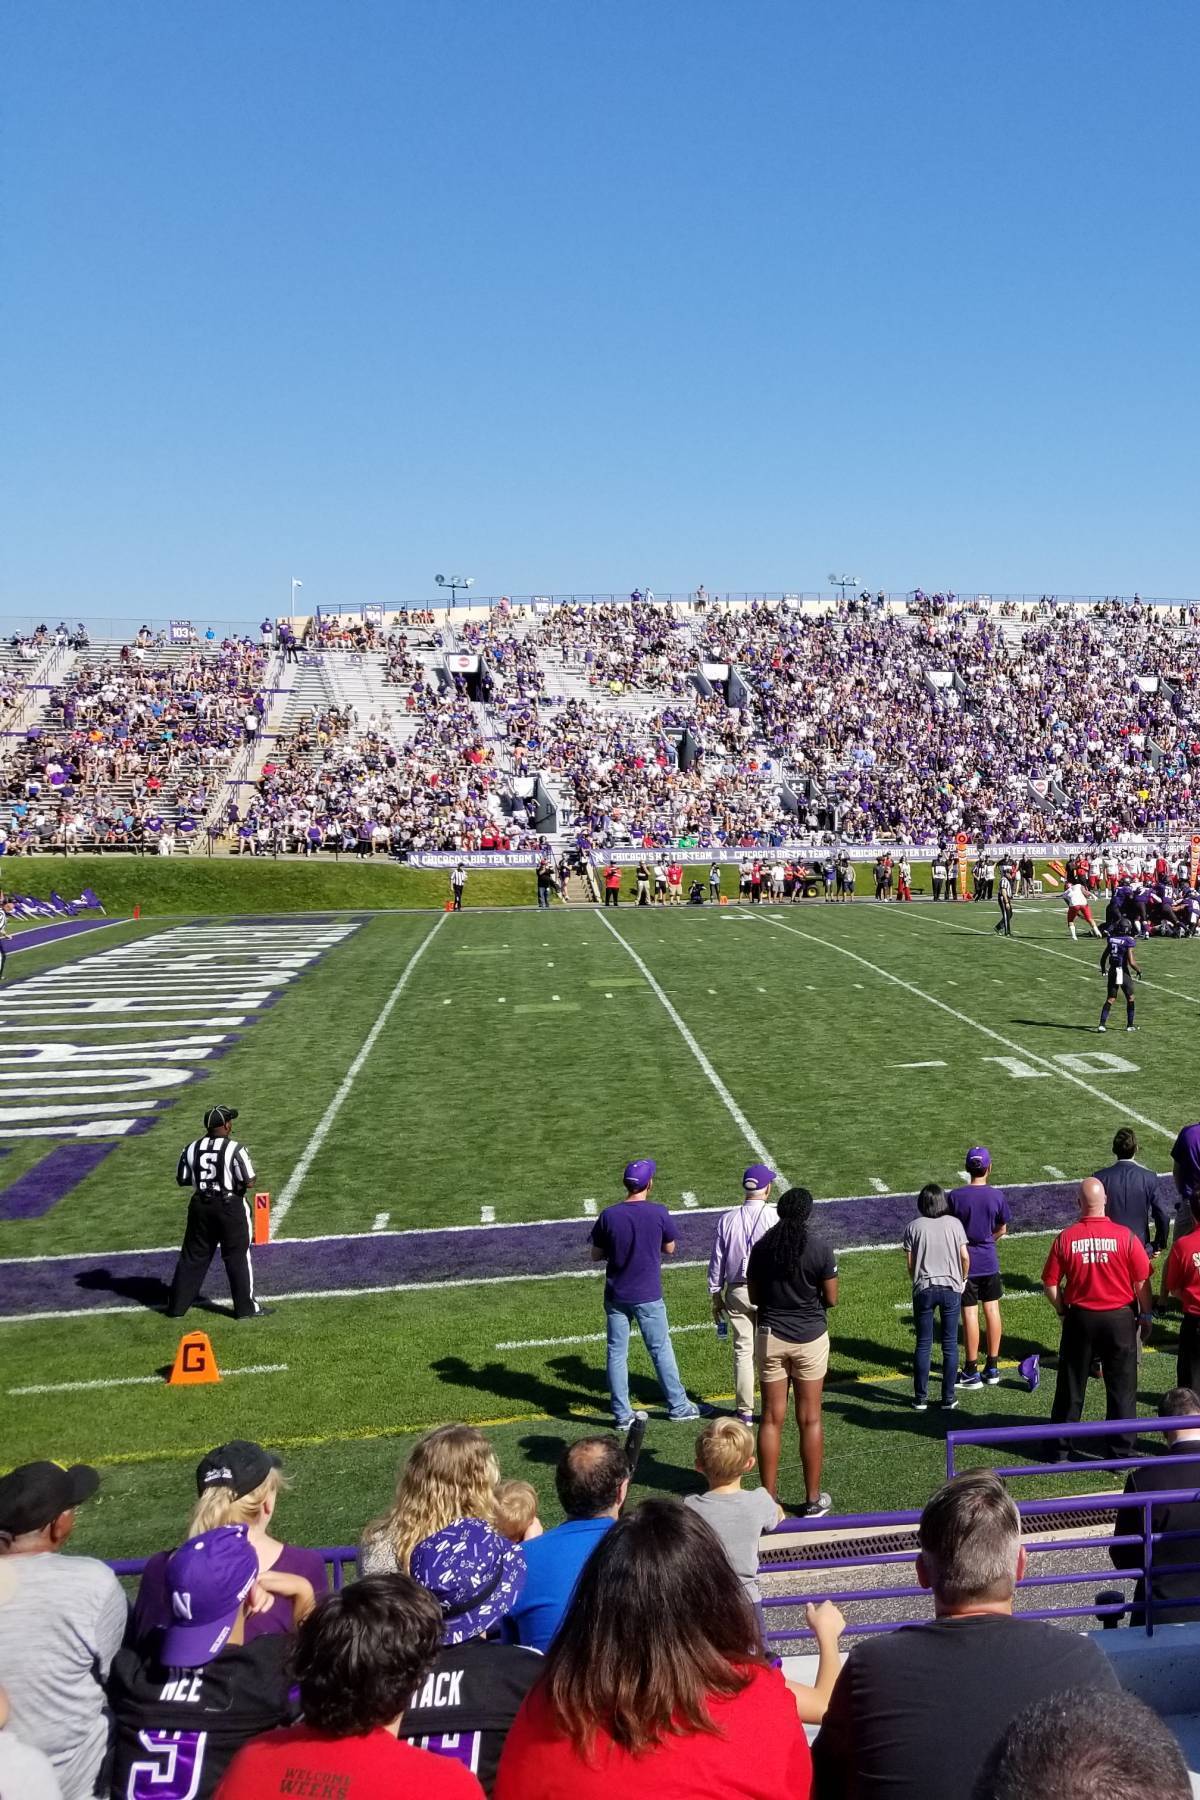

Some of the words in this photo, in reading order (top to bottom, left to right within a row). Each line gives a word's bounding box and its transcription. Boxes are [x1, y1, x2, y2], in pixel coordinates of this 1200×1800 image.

[173, 627, 189, 637] 103
[422, 854, 468, 864] CHICAGO'S
[470, 854, 486, 864] BIG
[488, 854, 506, 864] TEN
[507, 854, 532, 863] TEAM
[611, 852, 654, 861] CHICAGO'S
[656, 852, 669, 860] BG
[690, 852, 712, 860] TEAM
[734, 851, 776, 859] CHICAGO'S
[980, 1052, 1141, 1078] 10
[200, 1152, 218, 1180] S
[257, 1196, 267, 1209] N
[1071, 1238, 1118, 1254] SUPERIOR
[182, 1343, 205, 1372] G
[172, 1591, 193, 1620] N
[410, 1669, 465, 1709] ACK
[280, 1779, 350, 1800] WEEKS
